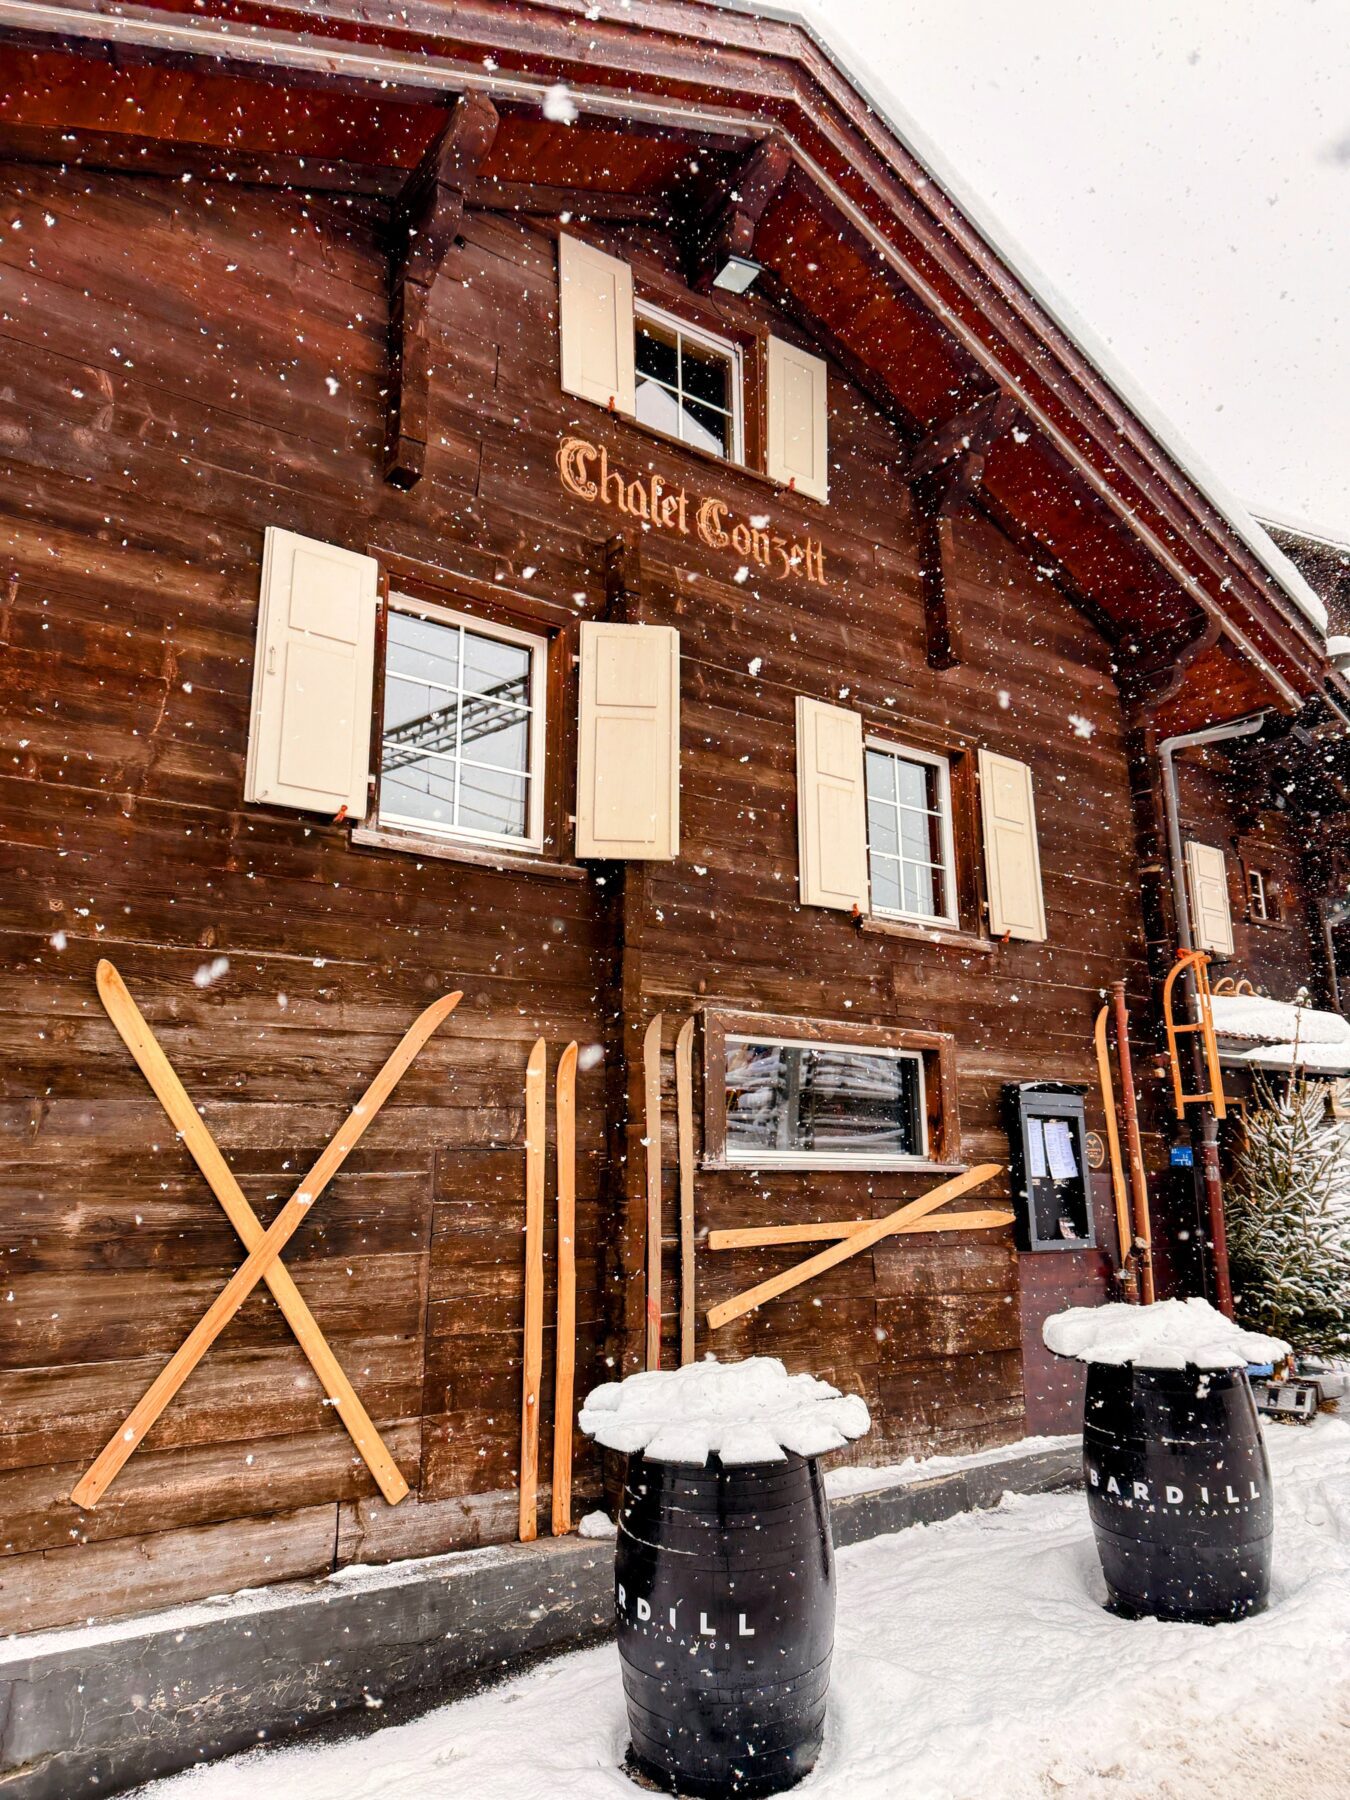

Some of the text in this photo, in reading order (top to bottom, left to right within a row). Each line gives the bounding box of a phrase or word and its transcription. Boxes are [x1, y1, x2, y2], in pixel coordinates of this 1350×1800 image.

[555, 436, 829, 587] Chalet Conzett
[1090, 1468, 1261, 1505] BARDILL
